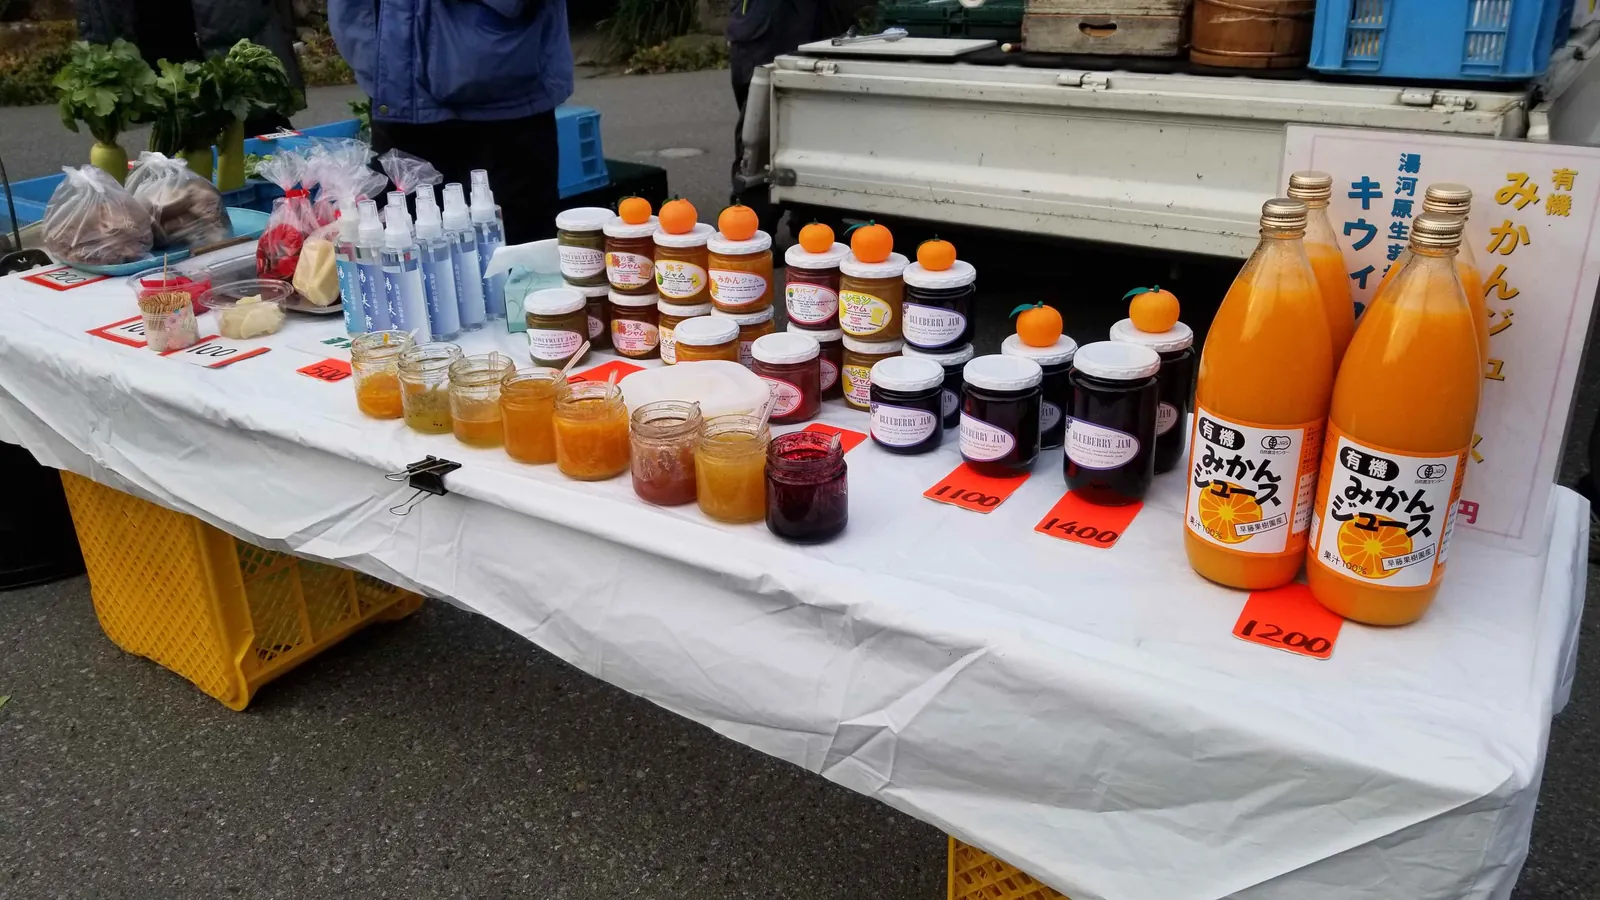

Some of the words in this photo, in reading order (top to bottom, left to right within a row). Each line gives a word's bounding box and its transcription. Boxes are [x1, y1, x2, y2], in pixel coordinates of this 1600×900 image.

[1545, 168, 1578, 217] 有機
[1382, 152, 1422, 279] 湯河原生ま
[620, 262, 641, 270] ジャム
[48, 270, 88, 285] 200
[665, 271, 686, 280] ジャム
[718, 275, 760, 285] みかんジャム
[844, 293, 871, 306] レモン
[846, 303, 867, 313] ジャム
[910, 314, 944, 327] BLUEBERRY
[948, 316, 960, 327] JAM
[185, 342, 238, 357] 100
[302, 365, 351, 380] 500
[880, 415, 916, 427] BLUEBERRY
[920, 416, 931, 426] JAM
[992, 434, 1006, 443] JAM
[1073, 431, 1113, 448] BLUEBERRY
[1116, 439, 1131, 448] JAM
[1202, 420, 1236, 449] 有機
[1202, 444, 1282, 484] みかん
[1346, 450, 1388, 479] 有機
[1194, 463, 1282, 507] ジュース
[934, 485, 1000, 507] 1100
[1344, 475, 1435, 515] みかん
[1331, 494, 1433, 539] ジュース
[1043, 518, 1118, 543] 1400
[1241, 619, 1332, 654] 1200
